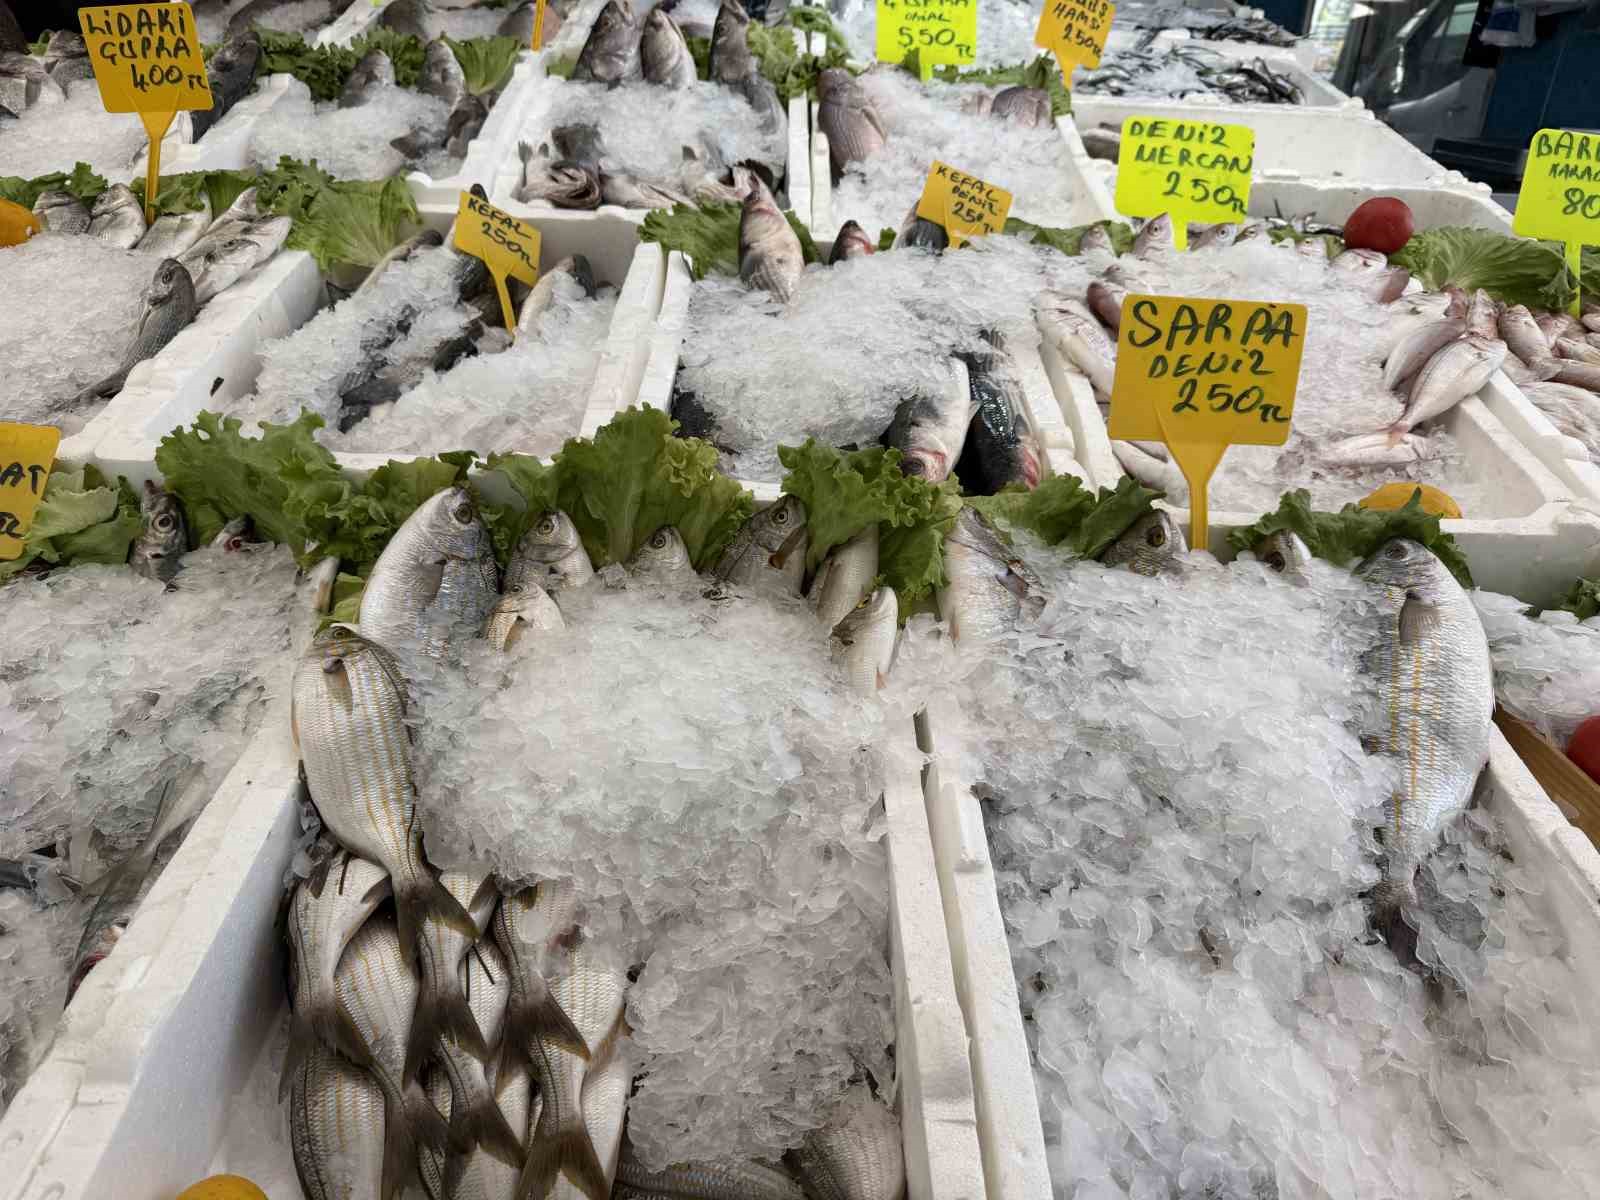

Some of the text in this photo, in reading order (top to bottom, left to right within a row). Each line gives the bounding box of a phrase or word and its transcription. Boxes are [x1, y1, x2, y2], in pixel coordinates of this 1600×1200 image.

[1536, 131, 1600, 162] BAR
[936, 166, 999, 202] KEFAL
[468, 198, 533, 240] KEFAL
[0, 462, 47, 495] AT
